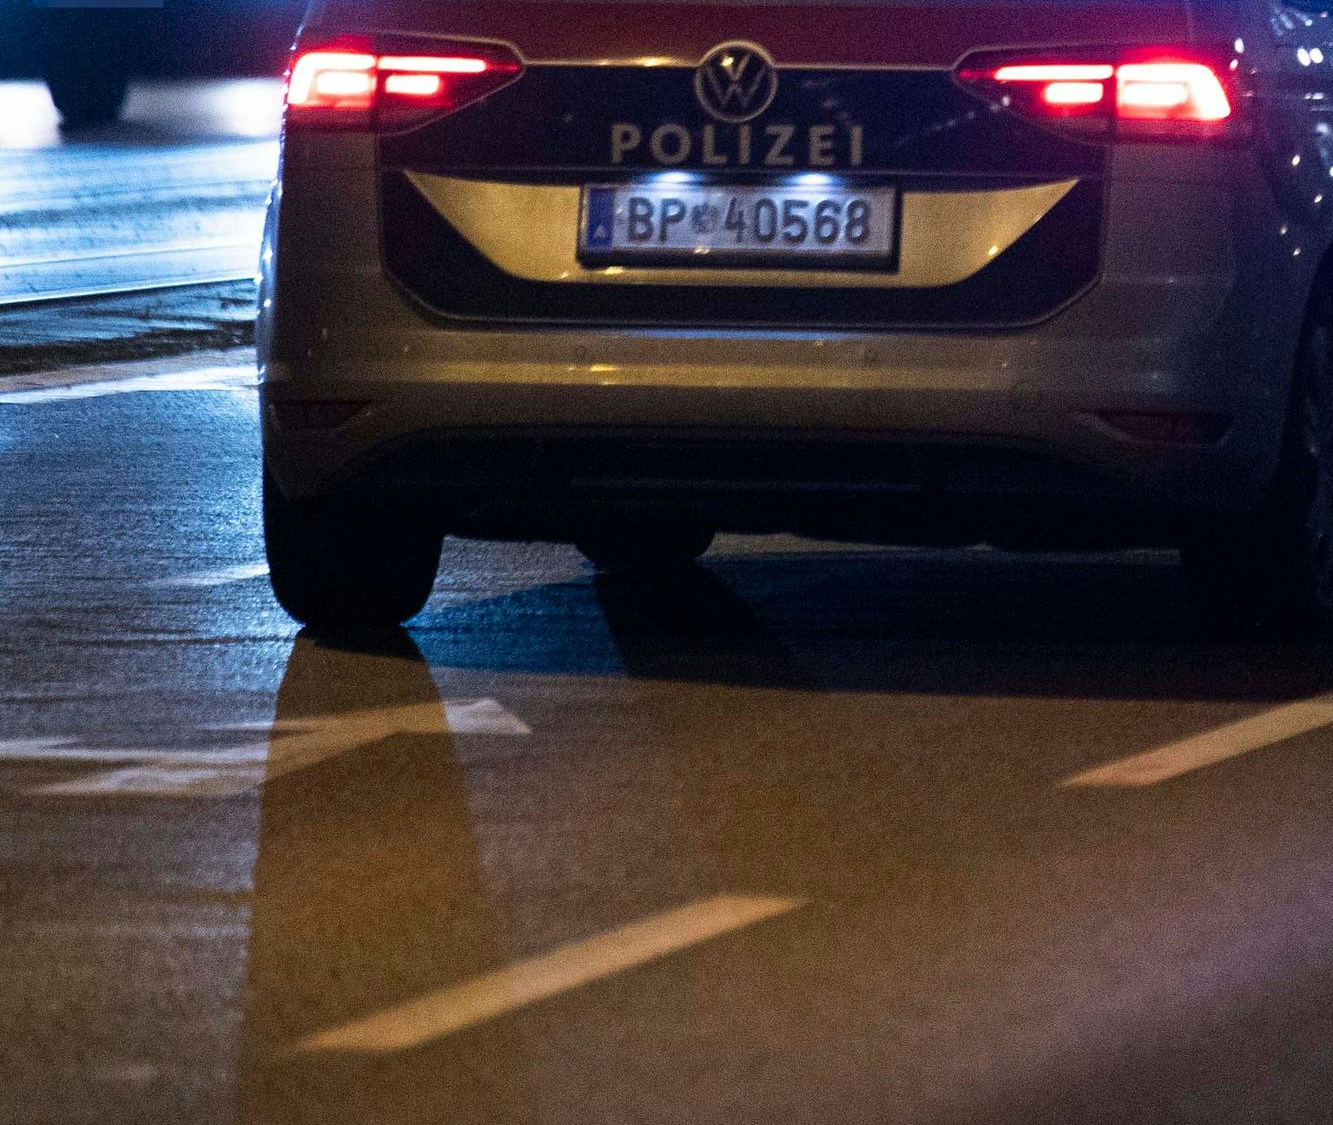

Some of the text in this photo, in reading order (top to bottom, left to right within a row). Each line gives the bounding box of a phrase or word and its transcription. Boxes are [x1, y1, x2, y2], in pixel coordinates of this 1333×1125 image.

[699, 42, 773, 118] VW
[610, 124, 863, 166] POLIZEI
[627, 197, 870, 244] BP 40568
